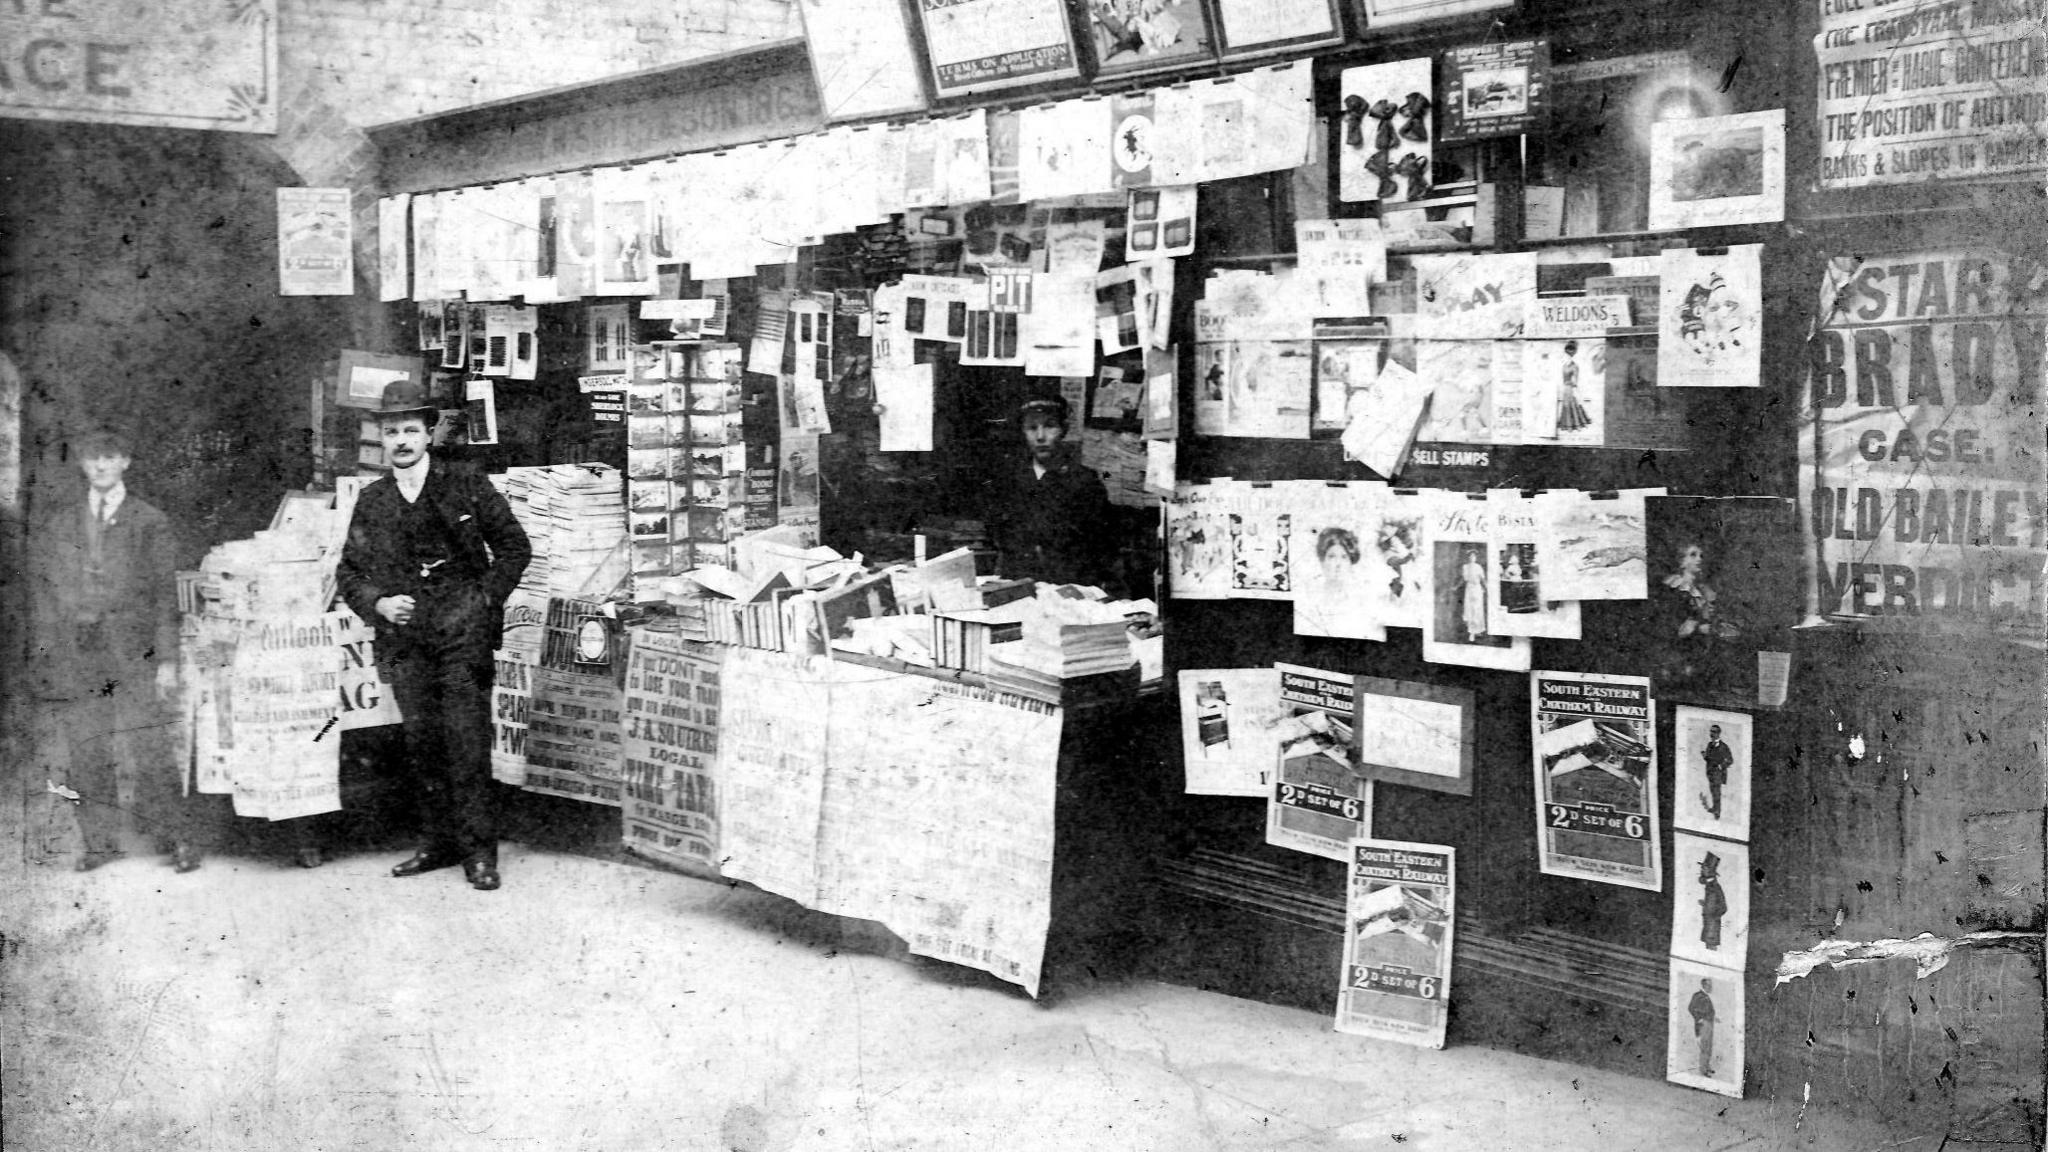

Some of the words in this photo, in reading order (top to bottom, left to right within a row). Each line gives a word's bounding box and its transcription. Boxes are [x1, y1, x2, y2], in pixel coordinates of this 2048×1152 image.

[939, 61, 976, 76] TERMS
[982, 57, 997, 68] ON
[1001, 45, 1067, 66] APPLICATION
[1826, 112, 1857, 142] THE
[1862, 103, 1936, 139] POSITION
[1942, 99, 1965, 130] OF
[1823, 154, 1867, 180] BANKS
[1874, 152, 1885, 176] &
[1891, 145, 1951, 174] SLOPES
[991, 275, 1031, 306] PIT
[1857, 258, 1997, 321] STAR
[1543, 305, 1608, 323] WELDONS
[1413, 450, 1439, 466] SELL
[1442, 451, 1490, 467] STAMPS
[1811, 486, 1882, 541] OLD
[1283, 673, 1315, 690] SOUTH
[1543, 681, 1580, 696] SOUTH
[1583, 685, 1640, 700] EASTERN
[1539, 698, 1591, 713] CHATHAM
[1594, 703, 1646, 718] RAILWAY
[1308, 794, 1329, 807] SET
[1329, 798, 1342, 809] OF
[1342, 798, 1358, 819] 6
[1584, 815, 1606, 827] SET
[1608, 819, 1622, 829] OF
[1624, 815, 1644, 839] 6
[1360, 849, 1391, 863] SOUTH
[1393, 852, 1443, 867] EASTERN
[1403, 869, 1448, 884] RAILWAY
[1382, 976, 1403, 988] SET
[1404, 979, 1418, 990] OF
[1418, 976, 1436, 999] 6
